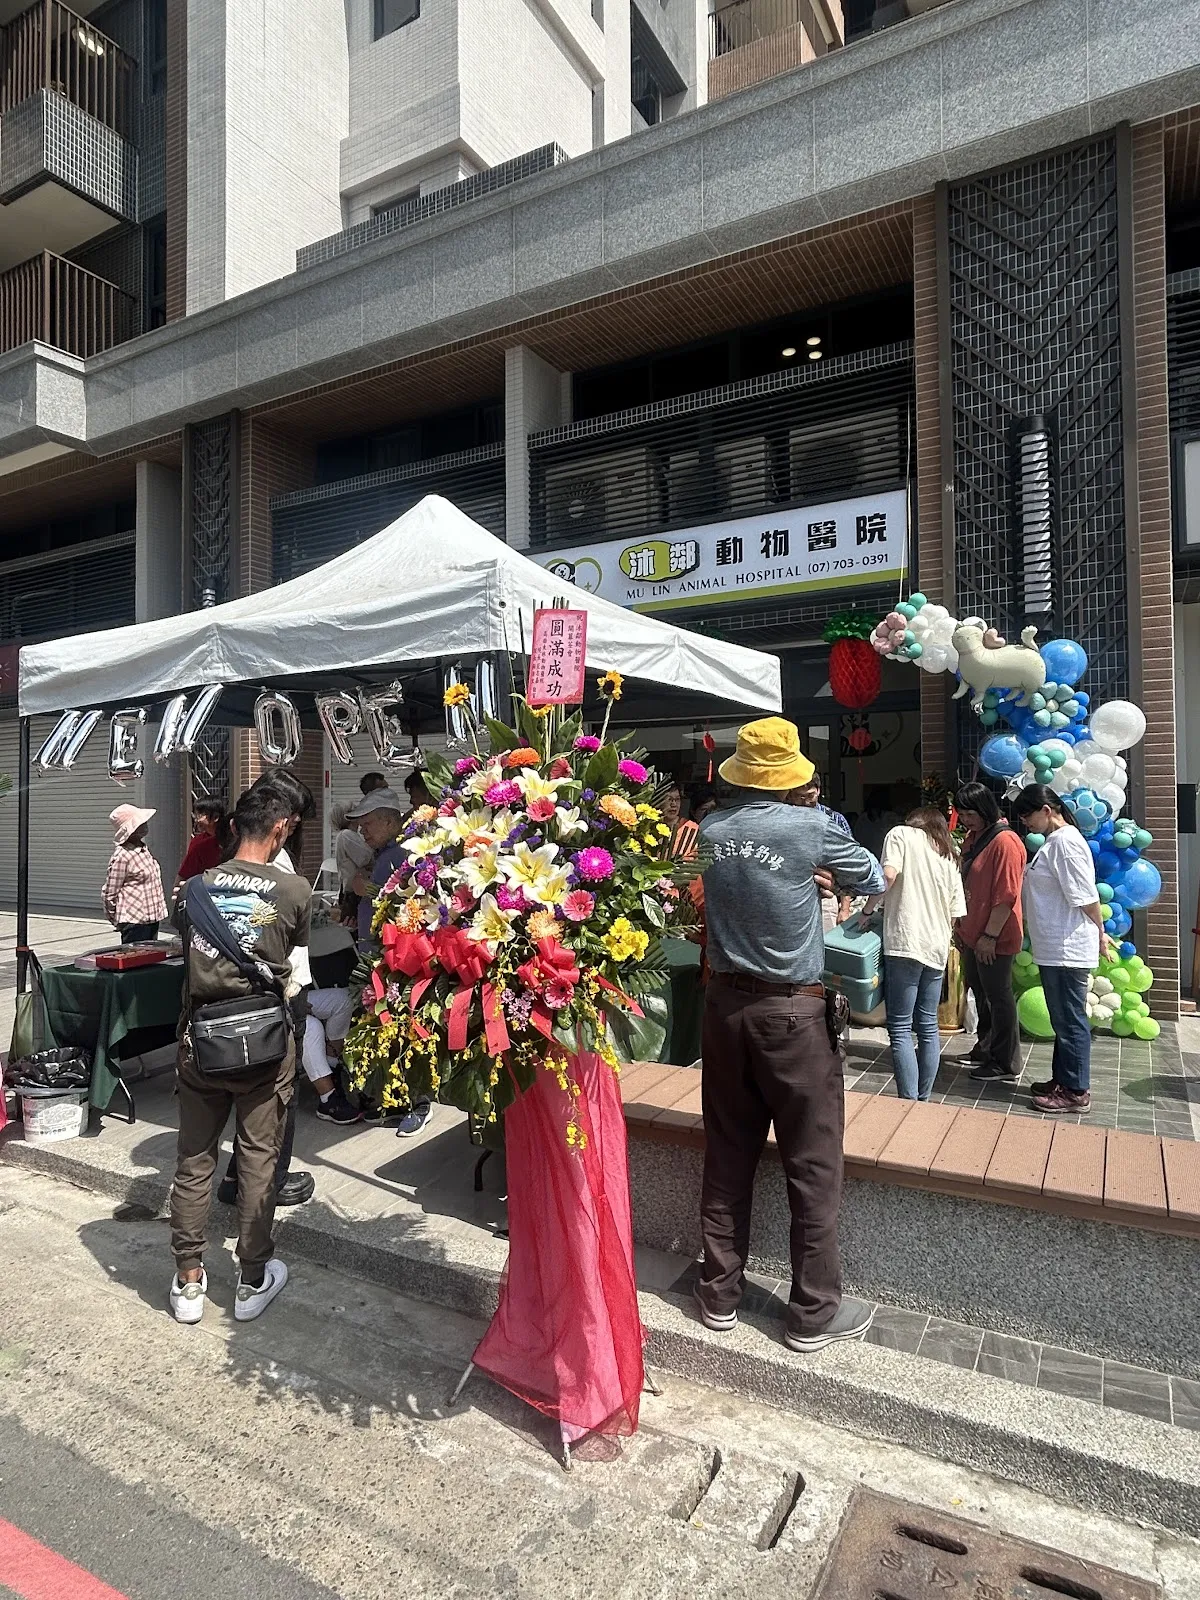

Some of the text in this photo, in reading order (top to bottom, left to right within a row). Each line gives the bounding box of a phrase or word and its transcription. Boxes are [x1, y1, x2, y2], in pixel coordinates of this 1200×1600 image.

[628, 512, 887, 579] 沐鄰 動物醫院
[626, 586, 645, 600] MU
[652, 583, 671, 596] LIN
[679, 576, 728, 592] ANIMAL
[735, 567, 802, 585] HOSPITAL
[807, 560, 831, 575] (07)
[546, 619, 565, 697] 圓滿成功
